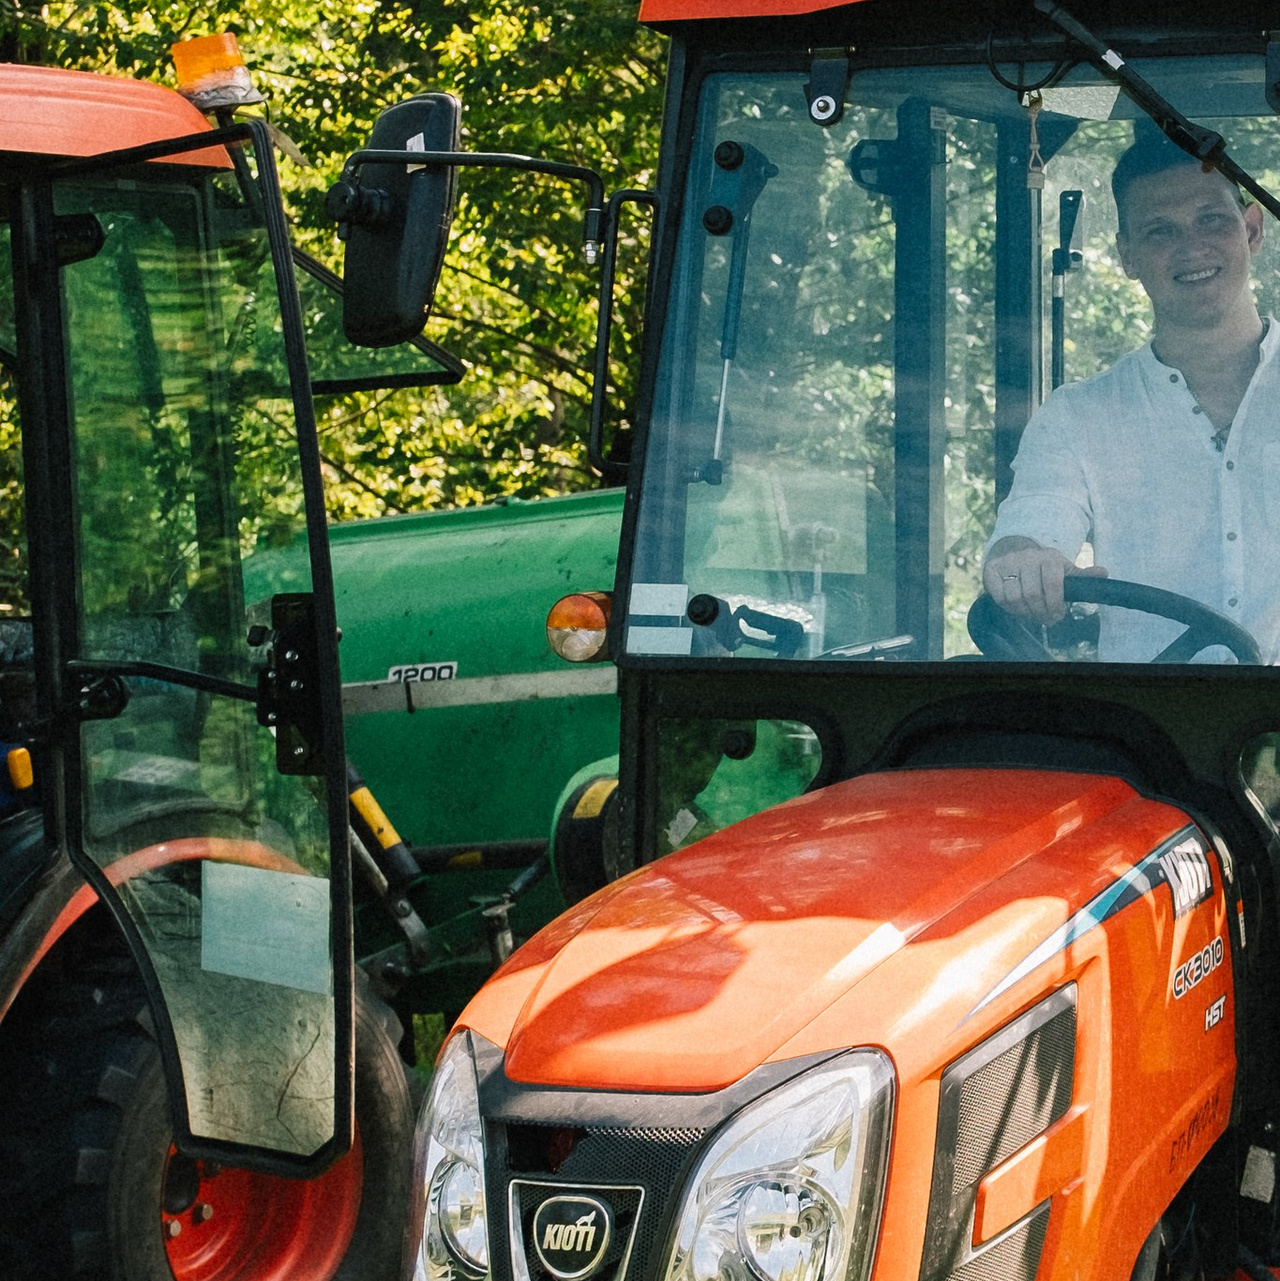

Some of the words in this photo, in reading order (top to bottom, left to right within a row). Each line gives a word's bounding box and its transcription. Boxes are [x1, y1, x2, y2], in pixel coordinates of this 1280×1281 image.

[391, 664, 454, 684] 1200
[1173, 935, 1224, 1000] CK3010
[1205, 995, 1227, 1031] HST
[542, 1223, 597, 1252] KIOTI
